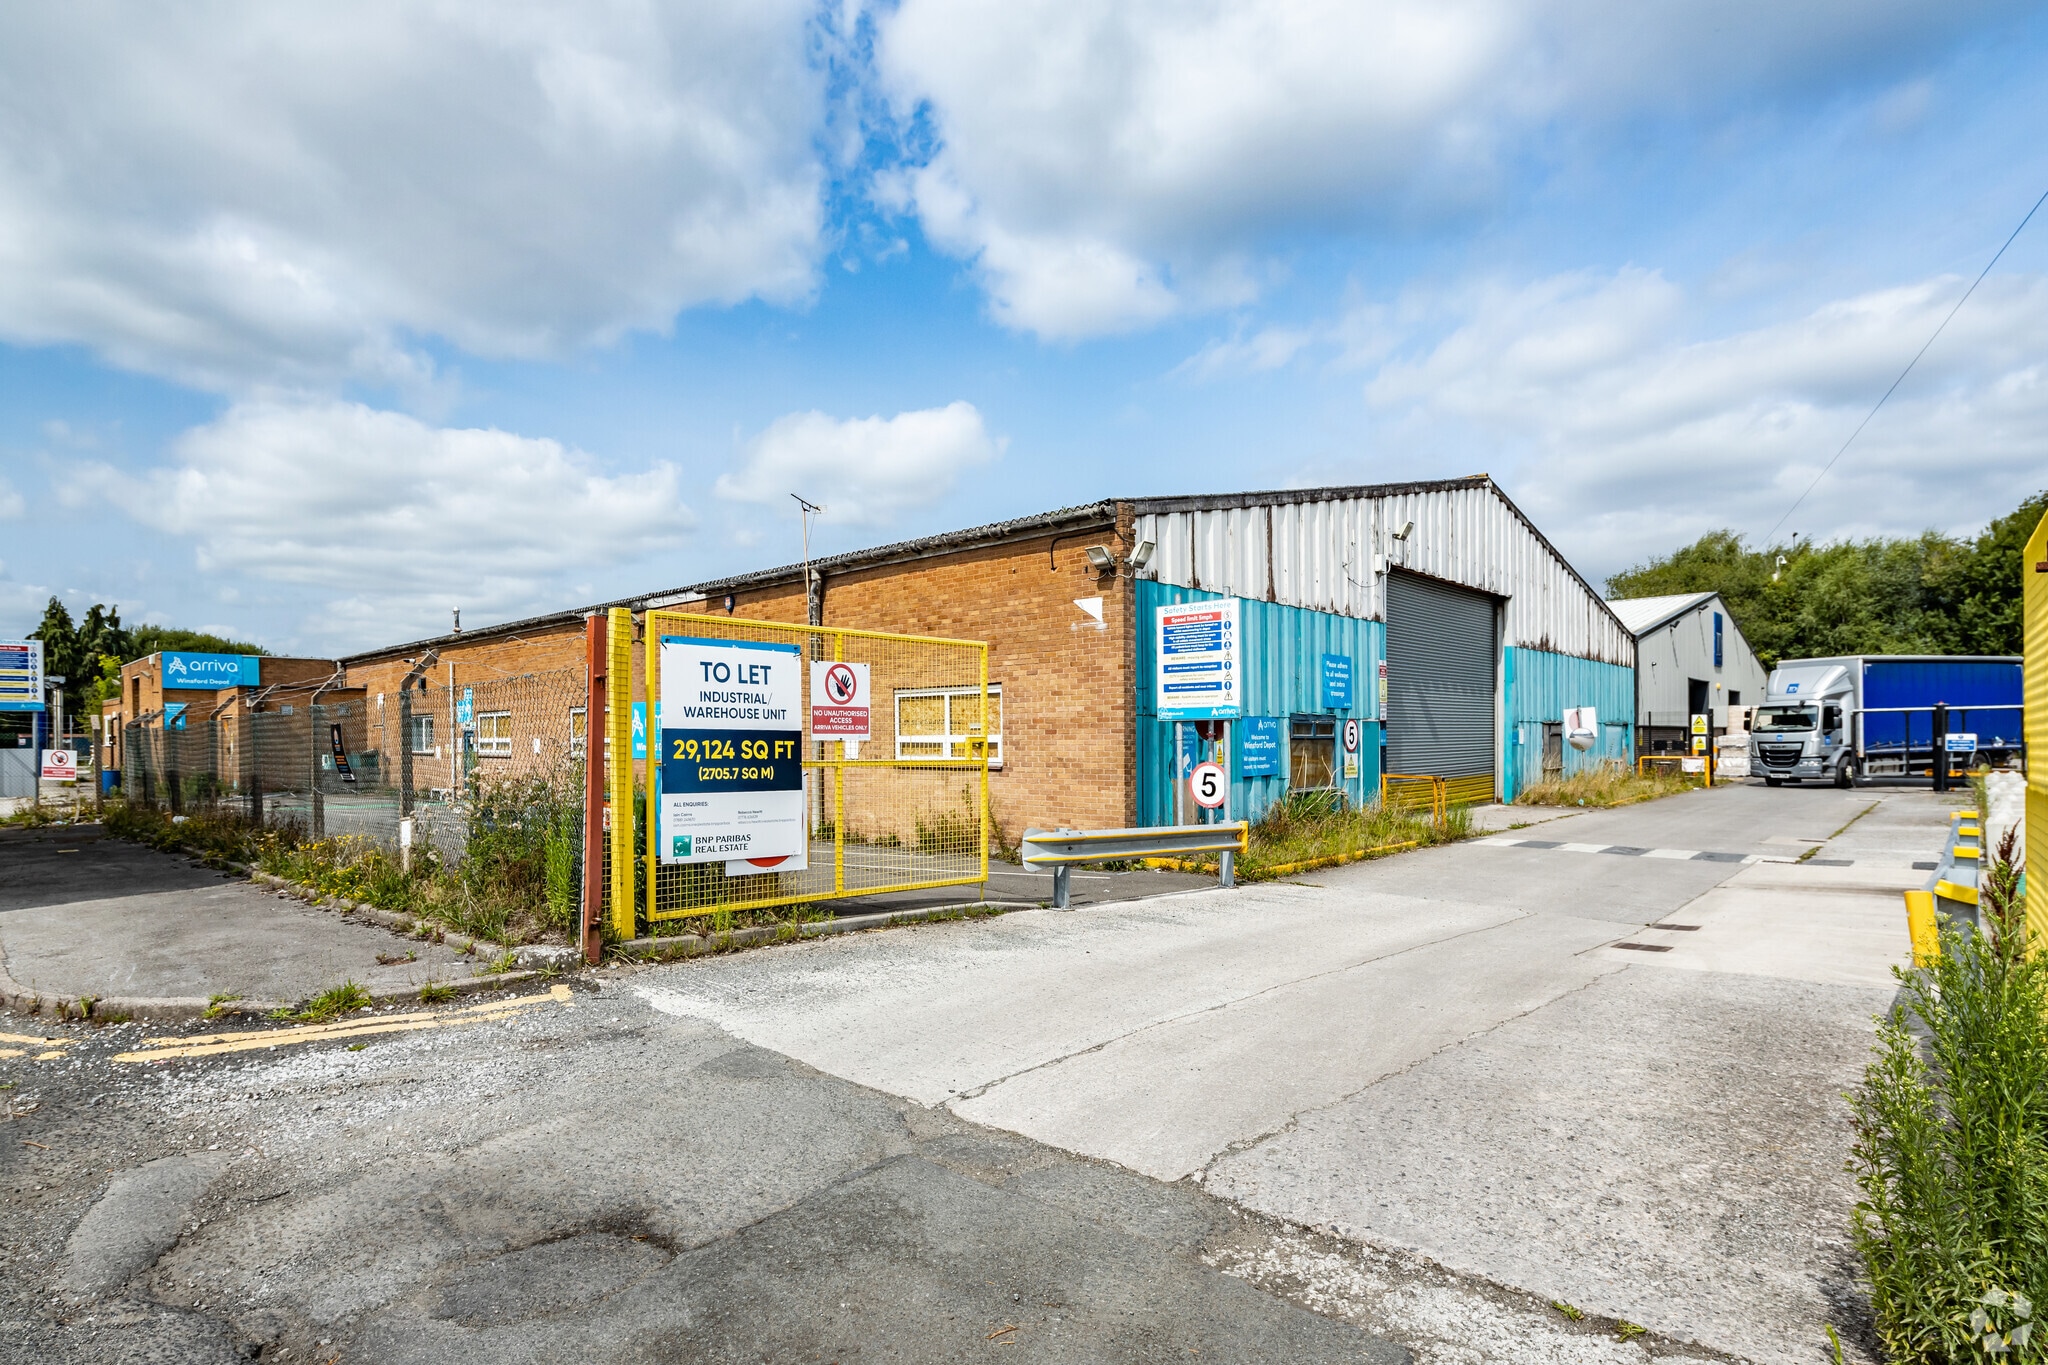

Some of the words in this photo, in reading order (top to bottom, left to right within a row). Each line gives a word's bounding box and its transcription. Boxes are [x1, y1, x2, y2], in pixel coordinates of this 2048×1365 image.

[1164, 607, 1187, 615] Safety
[1189, 604, 1213, 612] Starts
[1171, 616, 1187, 624] Speed
[189, 659, 238, 673] arriva
[700, 661, 731, 683] TO
[738, 663, 771, 685] LET
[700, 691, 772, 705] INDUSTRIAL/
[683, 706, 760, 720] WAREHOUSE
[763, 708, 787, 721] UNIT
[1218, 707, 1236, 715] arriva
[1349, 726, 1354, 745] 5
[673, 739, 735, 763] 29,124
[741, 739, 769, 761] SQ
[774, 740, 795, 759] FT
[1244, 741, 1263, 749] Winsford
[1263, 741, 1276, 750] Depot
[698, 766, 739, 781] (2705.7
[741, 768, 758, 779] SQ
[761, 766, 774, 780] M)
[1201, 772, 1217, 797] 5
[695, 836, 714, 845] BNP
[716, 834, 752, 843] PARIBAS
[695, 845, 717, 854] REAL
[719, 843, 749, 853] ESTATE
